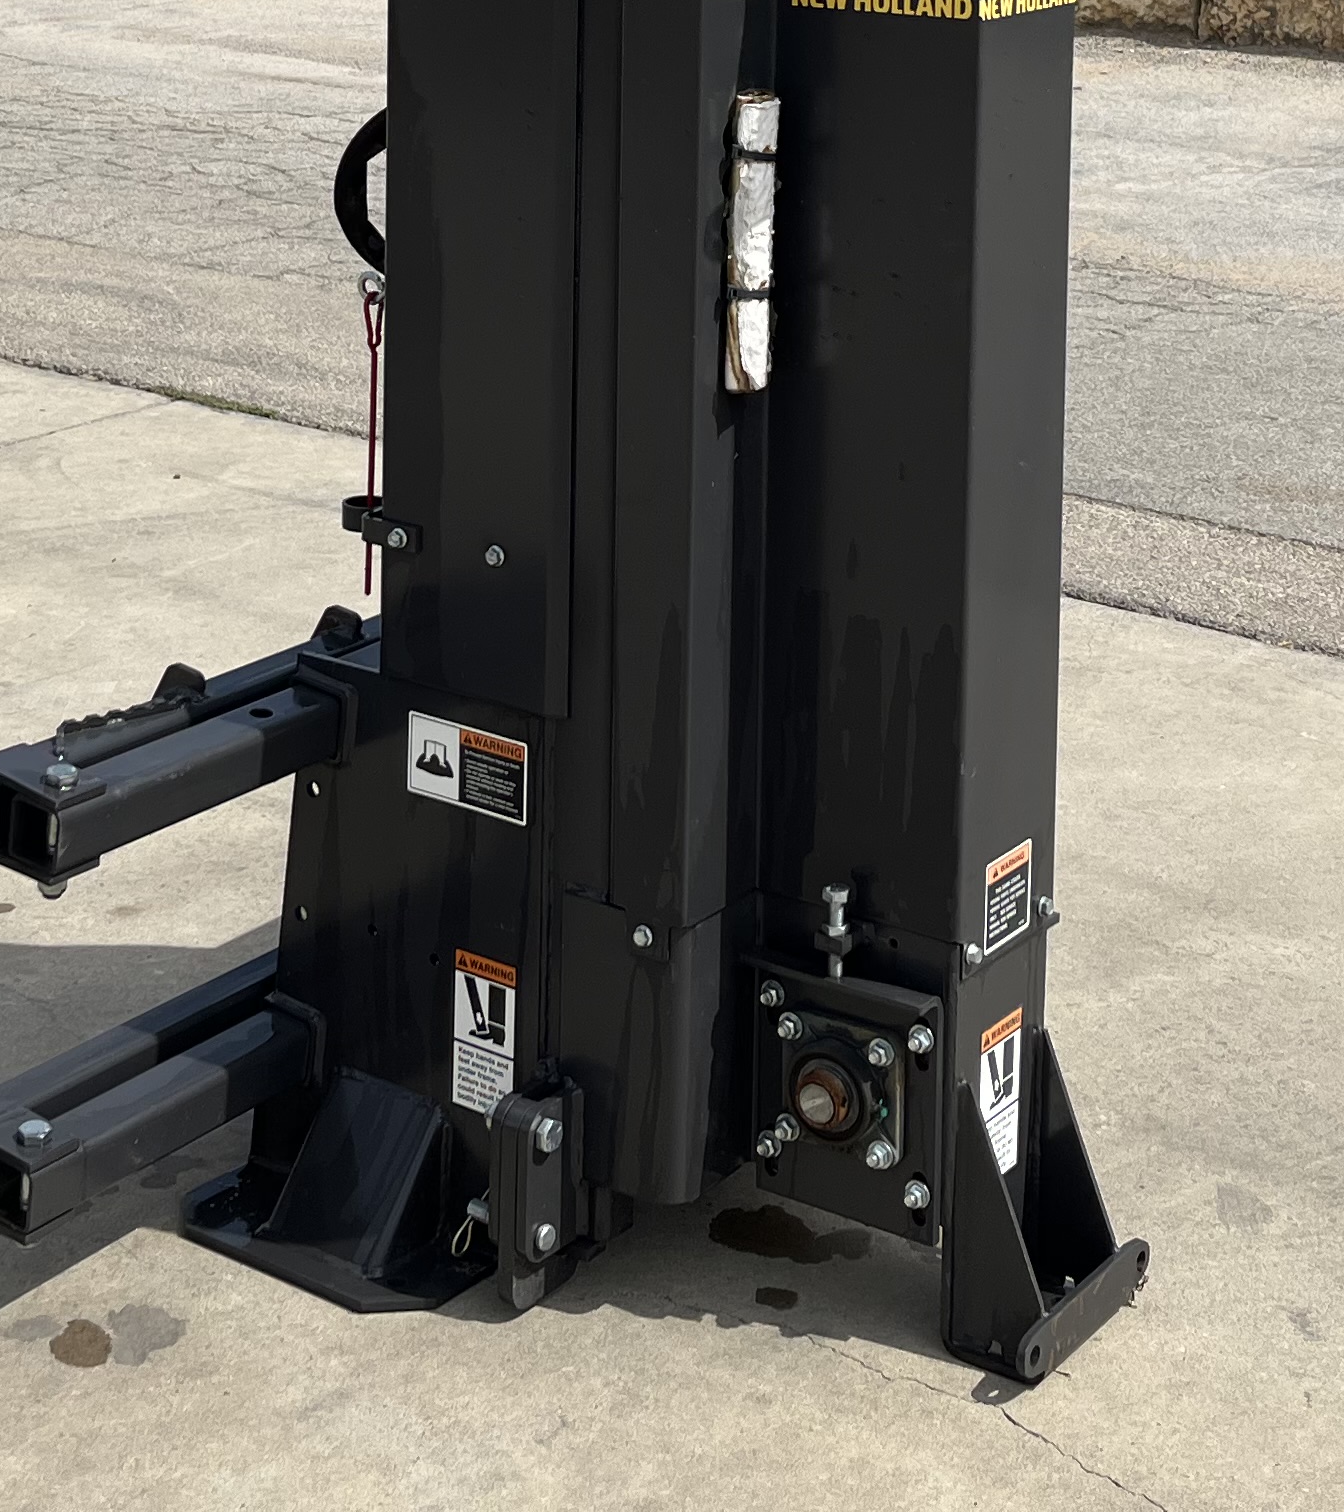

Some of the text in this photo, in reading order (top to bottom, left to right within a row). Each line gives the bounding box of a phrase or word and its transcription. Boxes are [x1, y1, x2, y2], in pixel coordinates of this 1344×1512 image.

[473, 734, 522, 760] WARNING
[468, 956, 514, 983] WARNING
[990, 1012, 1021, 1041] WARNING
